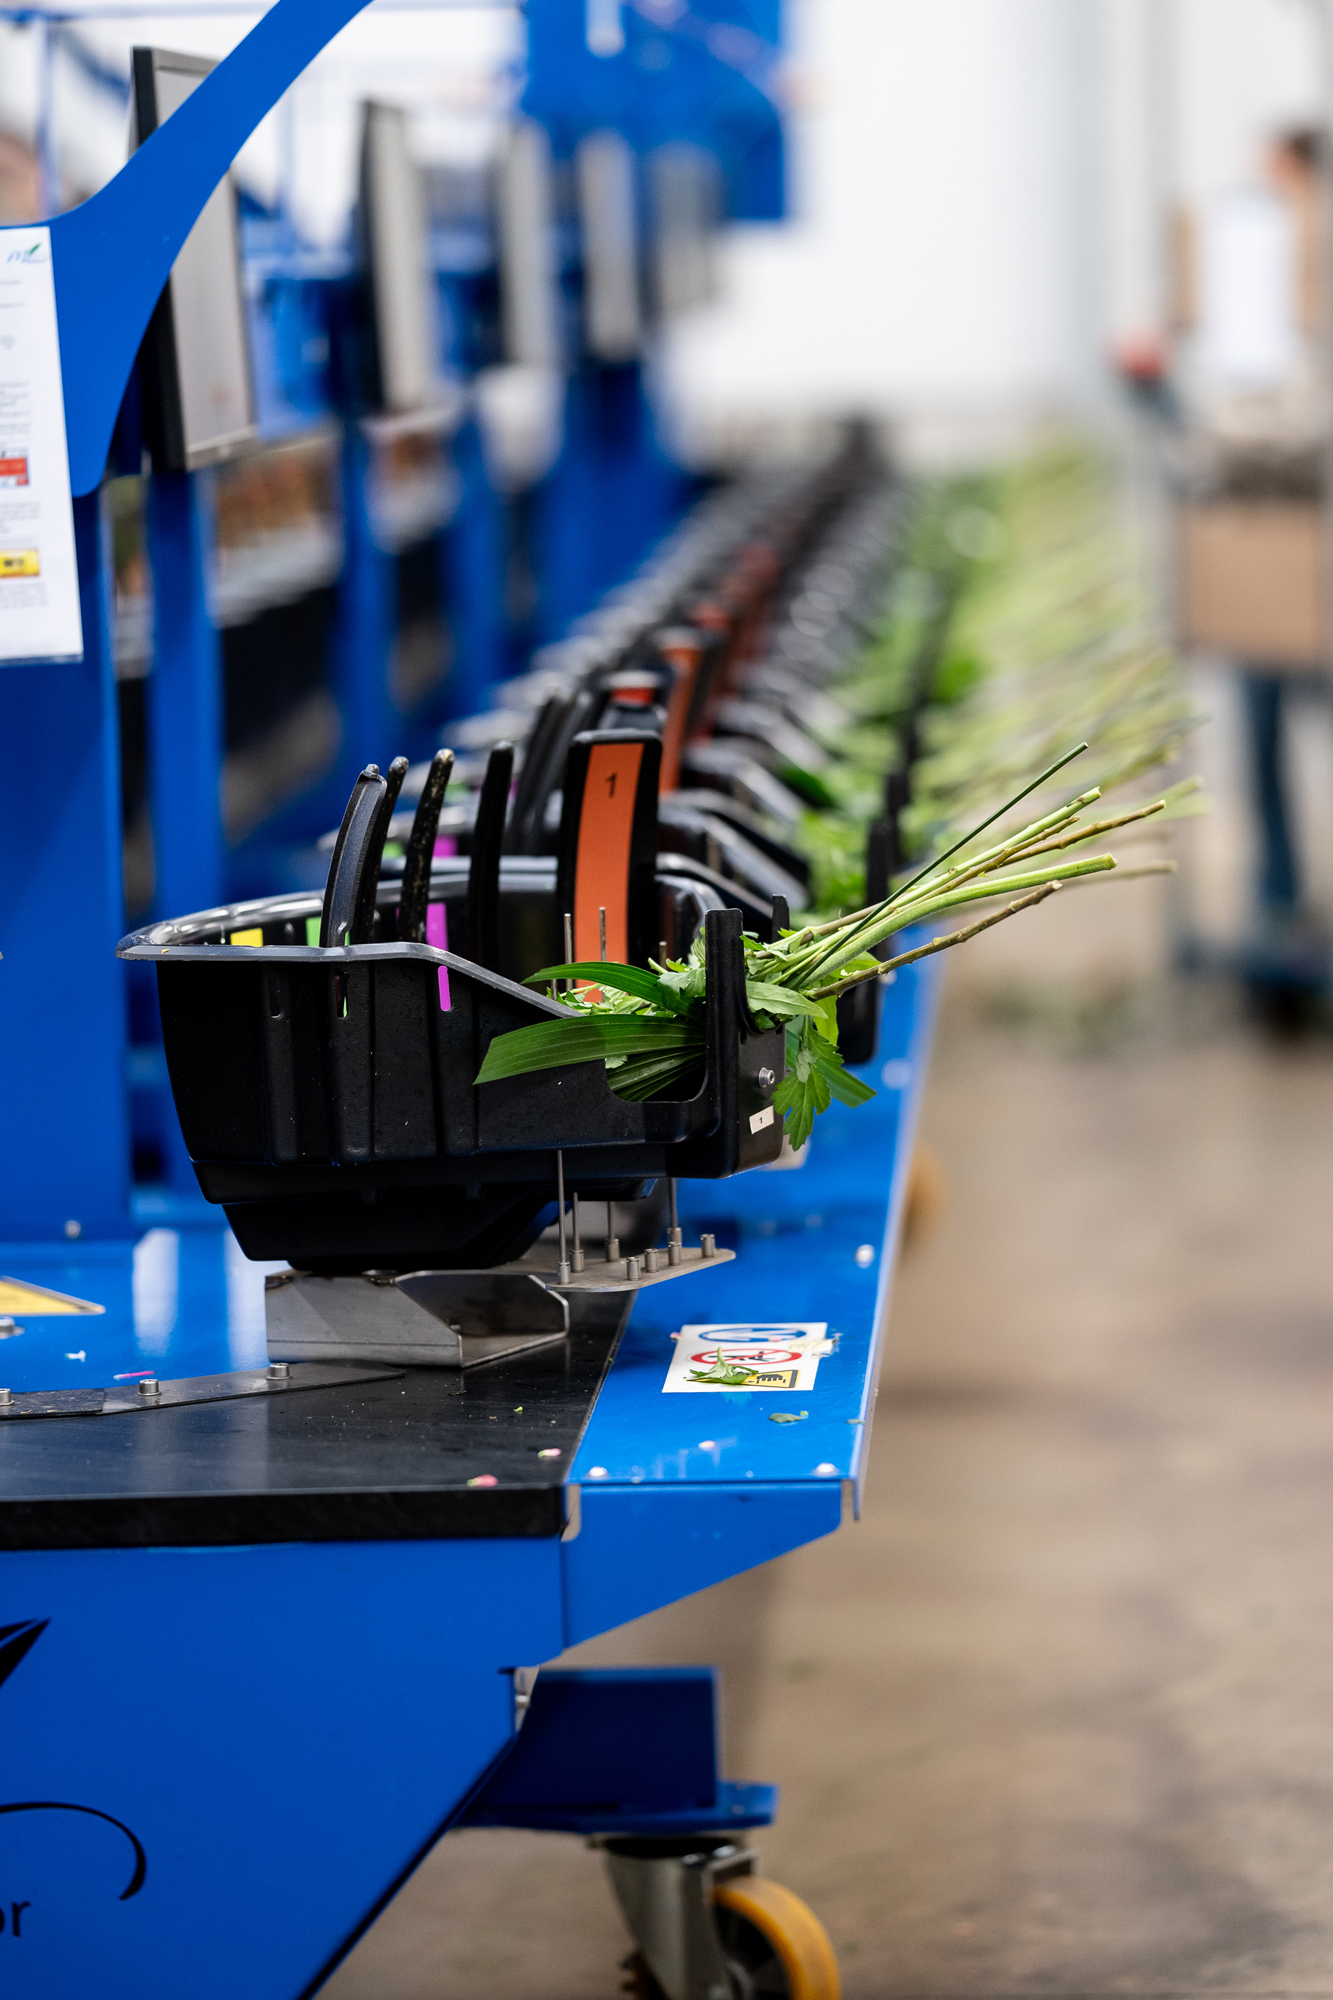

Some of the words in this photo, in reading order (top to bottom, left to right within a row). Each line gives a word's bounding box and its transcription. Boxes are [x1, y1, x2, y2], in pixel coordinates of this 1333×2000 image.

[605, 773, 616, 798] 1
[759, 1116, 763, 1124] 1
[0, 1901, 30, 1937] r
